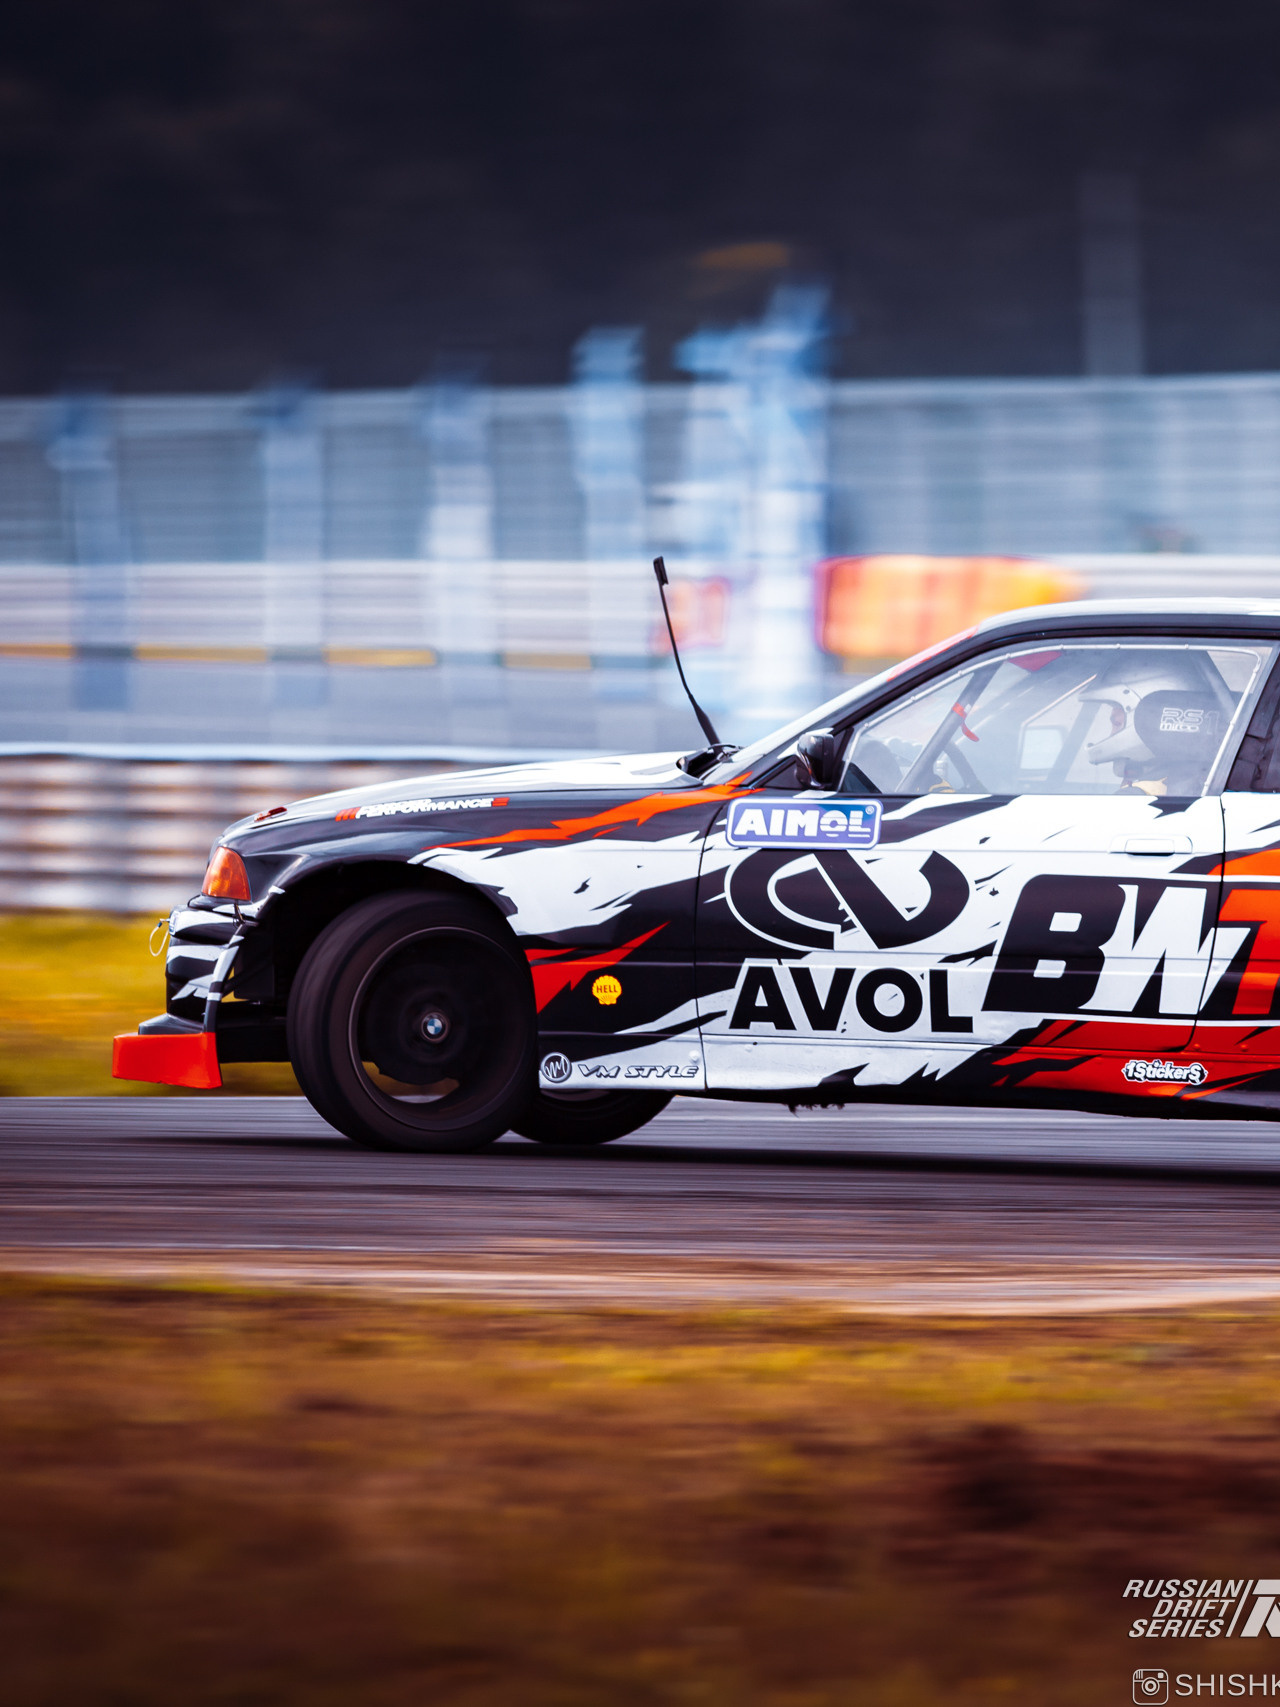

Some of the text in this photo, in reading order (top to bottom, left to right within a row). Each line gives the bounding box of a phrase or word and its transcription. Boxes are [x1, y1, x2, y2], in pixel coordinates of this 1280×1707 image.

[597, 985, 618, 994] HELL
[729, 964, 973, 1033] AVOL
[578, 1064, 699, 1079] VM STYLE
